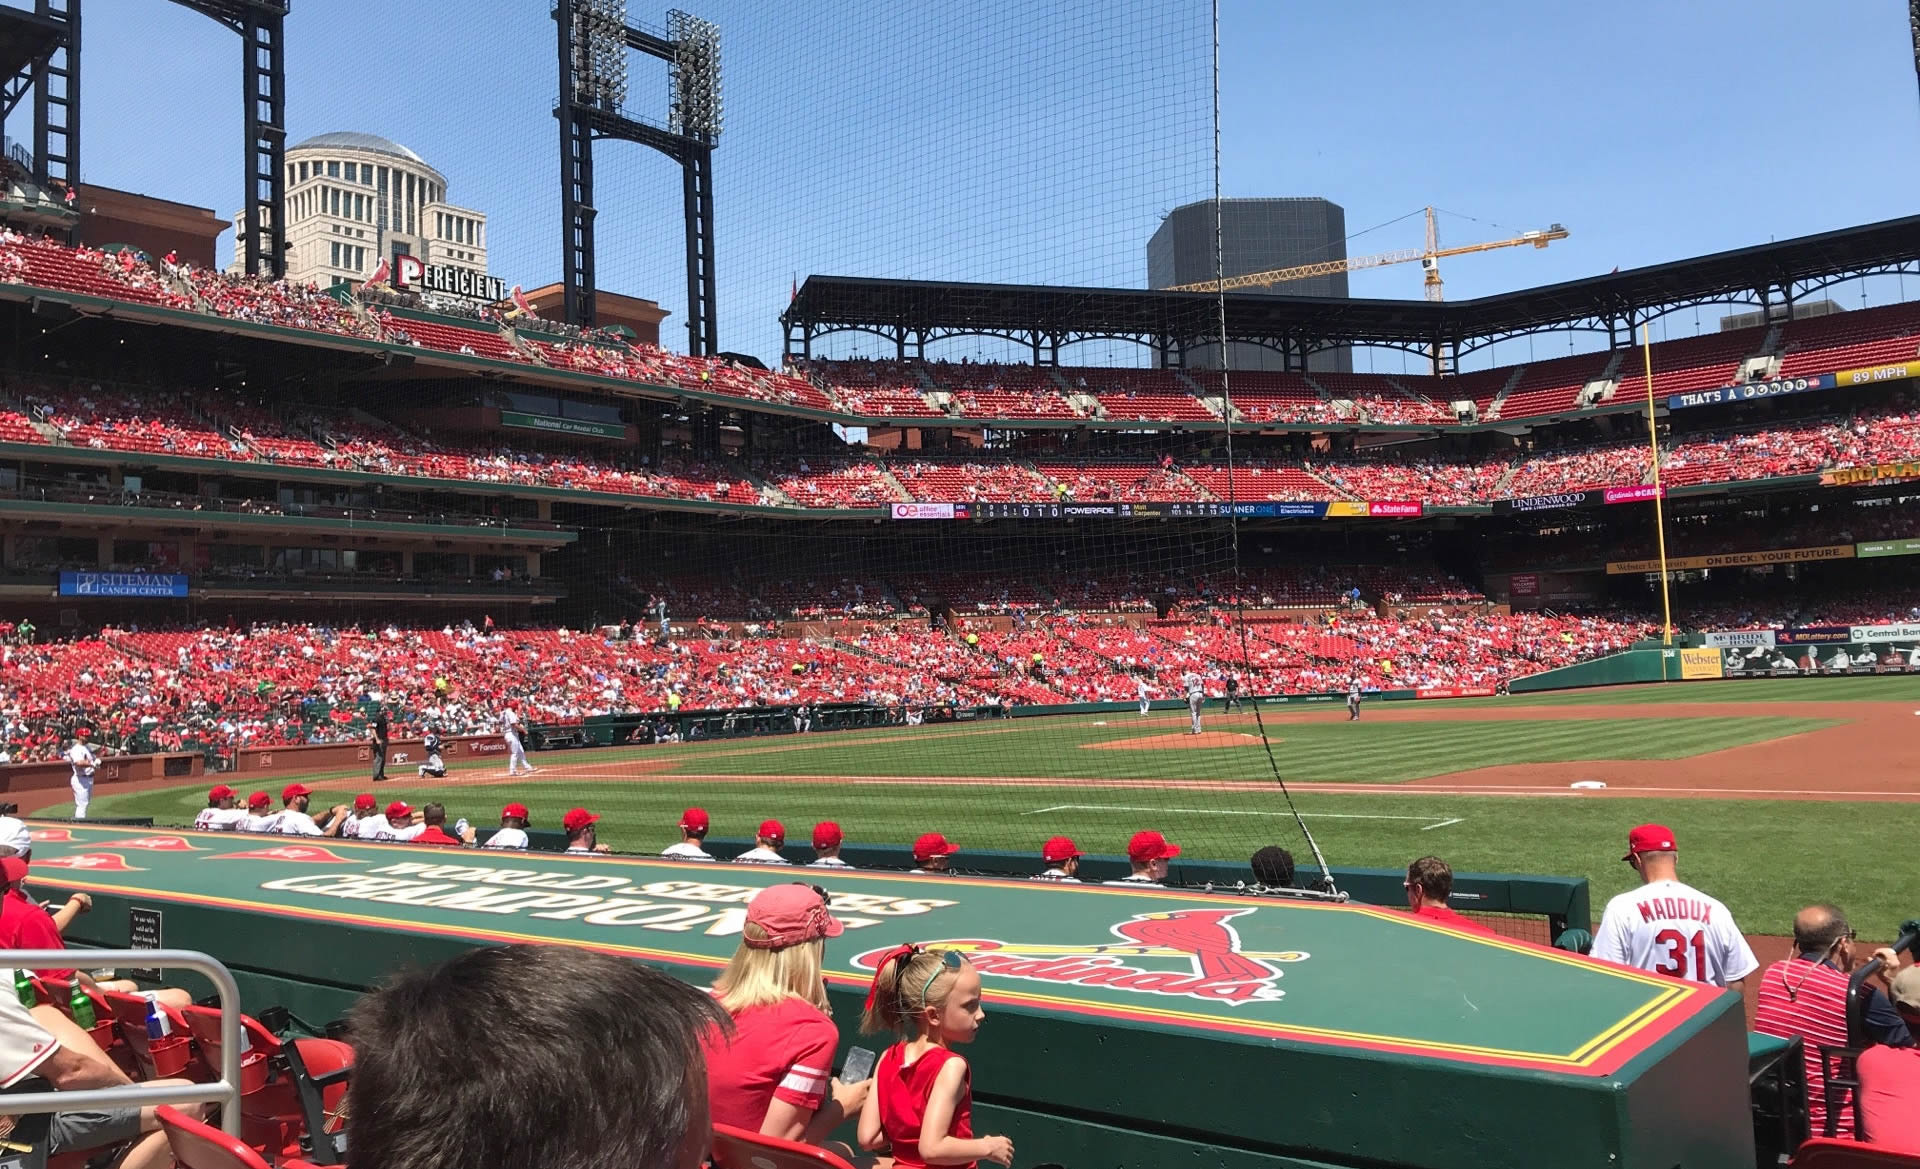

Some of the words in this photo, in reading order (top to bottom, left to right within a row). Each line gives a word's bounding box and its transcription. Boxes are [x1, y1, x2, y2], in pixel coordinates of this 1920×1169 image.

[1853, 371, 1870, 383] 89
[1874, 367, 1908, 380] MPH
[1681, 390, 1721, 406] THAT'S
[1728, 389, 1737, 400] A
[1835, 468, 1873, 485] BIG
[1511, 492, 1585, 508] LINDENWOOD
[1023, 508, 1029, 517] 0
[1038, 508, 1043, 517] 1
[1051, 508, 1058, 517] 0
[1616, 563, 1646, 571] Webster
[1648, 560, 1689, 571] Uniersity
[1707, 557, 1722, 566] ON
[1761, 551, 1791, 561] YOUR
[101, 573, 173, 586] SITEMAN
[101, 586, 137, 594] CANCER
[139, 587, 174, 595] CENTER
[1866, 628, 1900, 638] Central
[1683, 653, 1720, 665] Webster
[480, 743, 506, 751] Fanatics
[366, 862, 633, 890] WORLD
[612, 880, 961, 916] SEES
[260, 874, 885, 937] CHAMPION
[1637, 897, 1713, 925] MADDUX
[1655, 928, 1707, 982] 31
[850, 938, 1284, 1006] Crdinals
